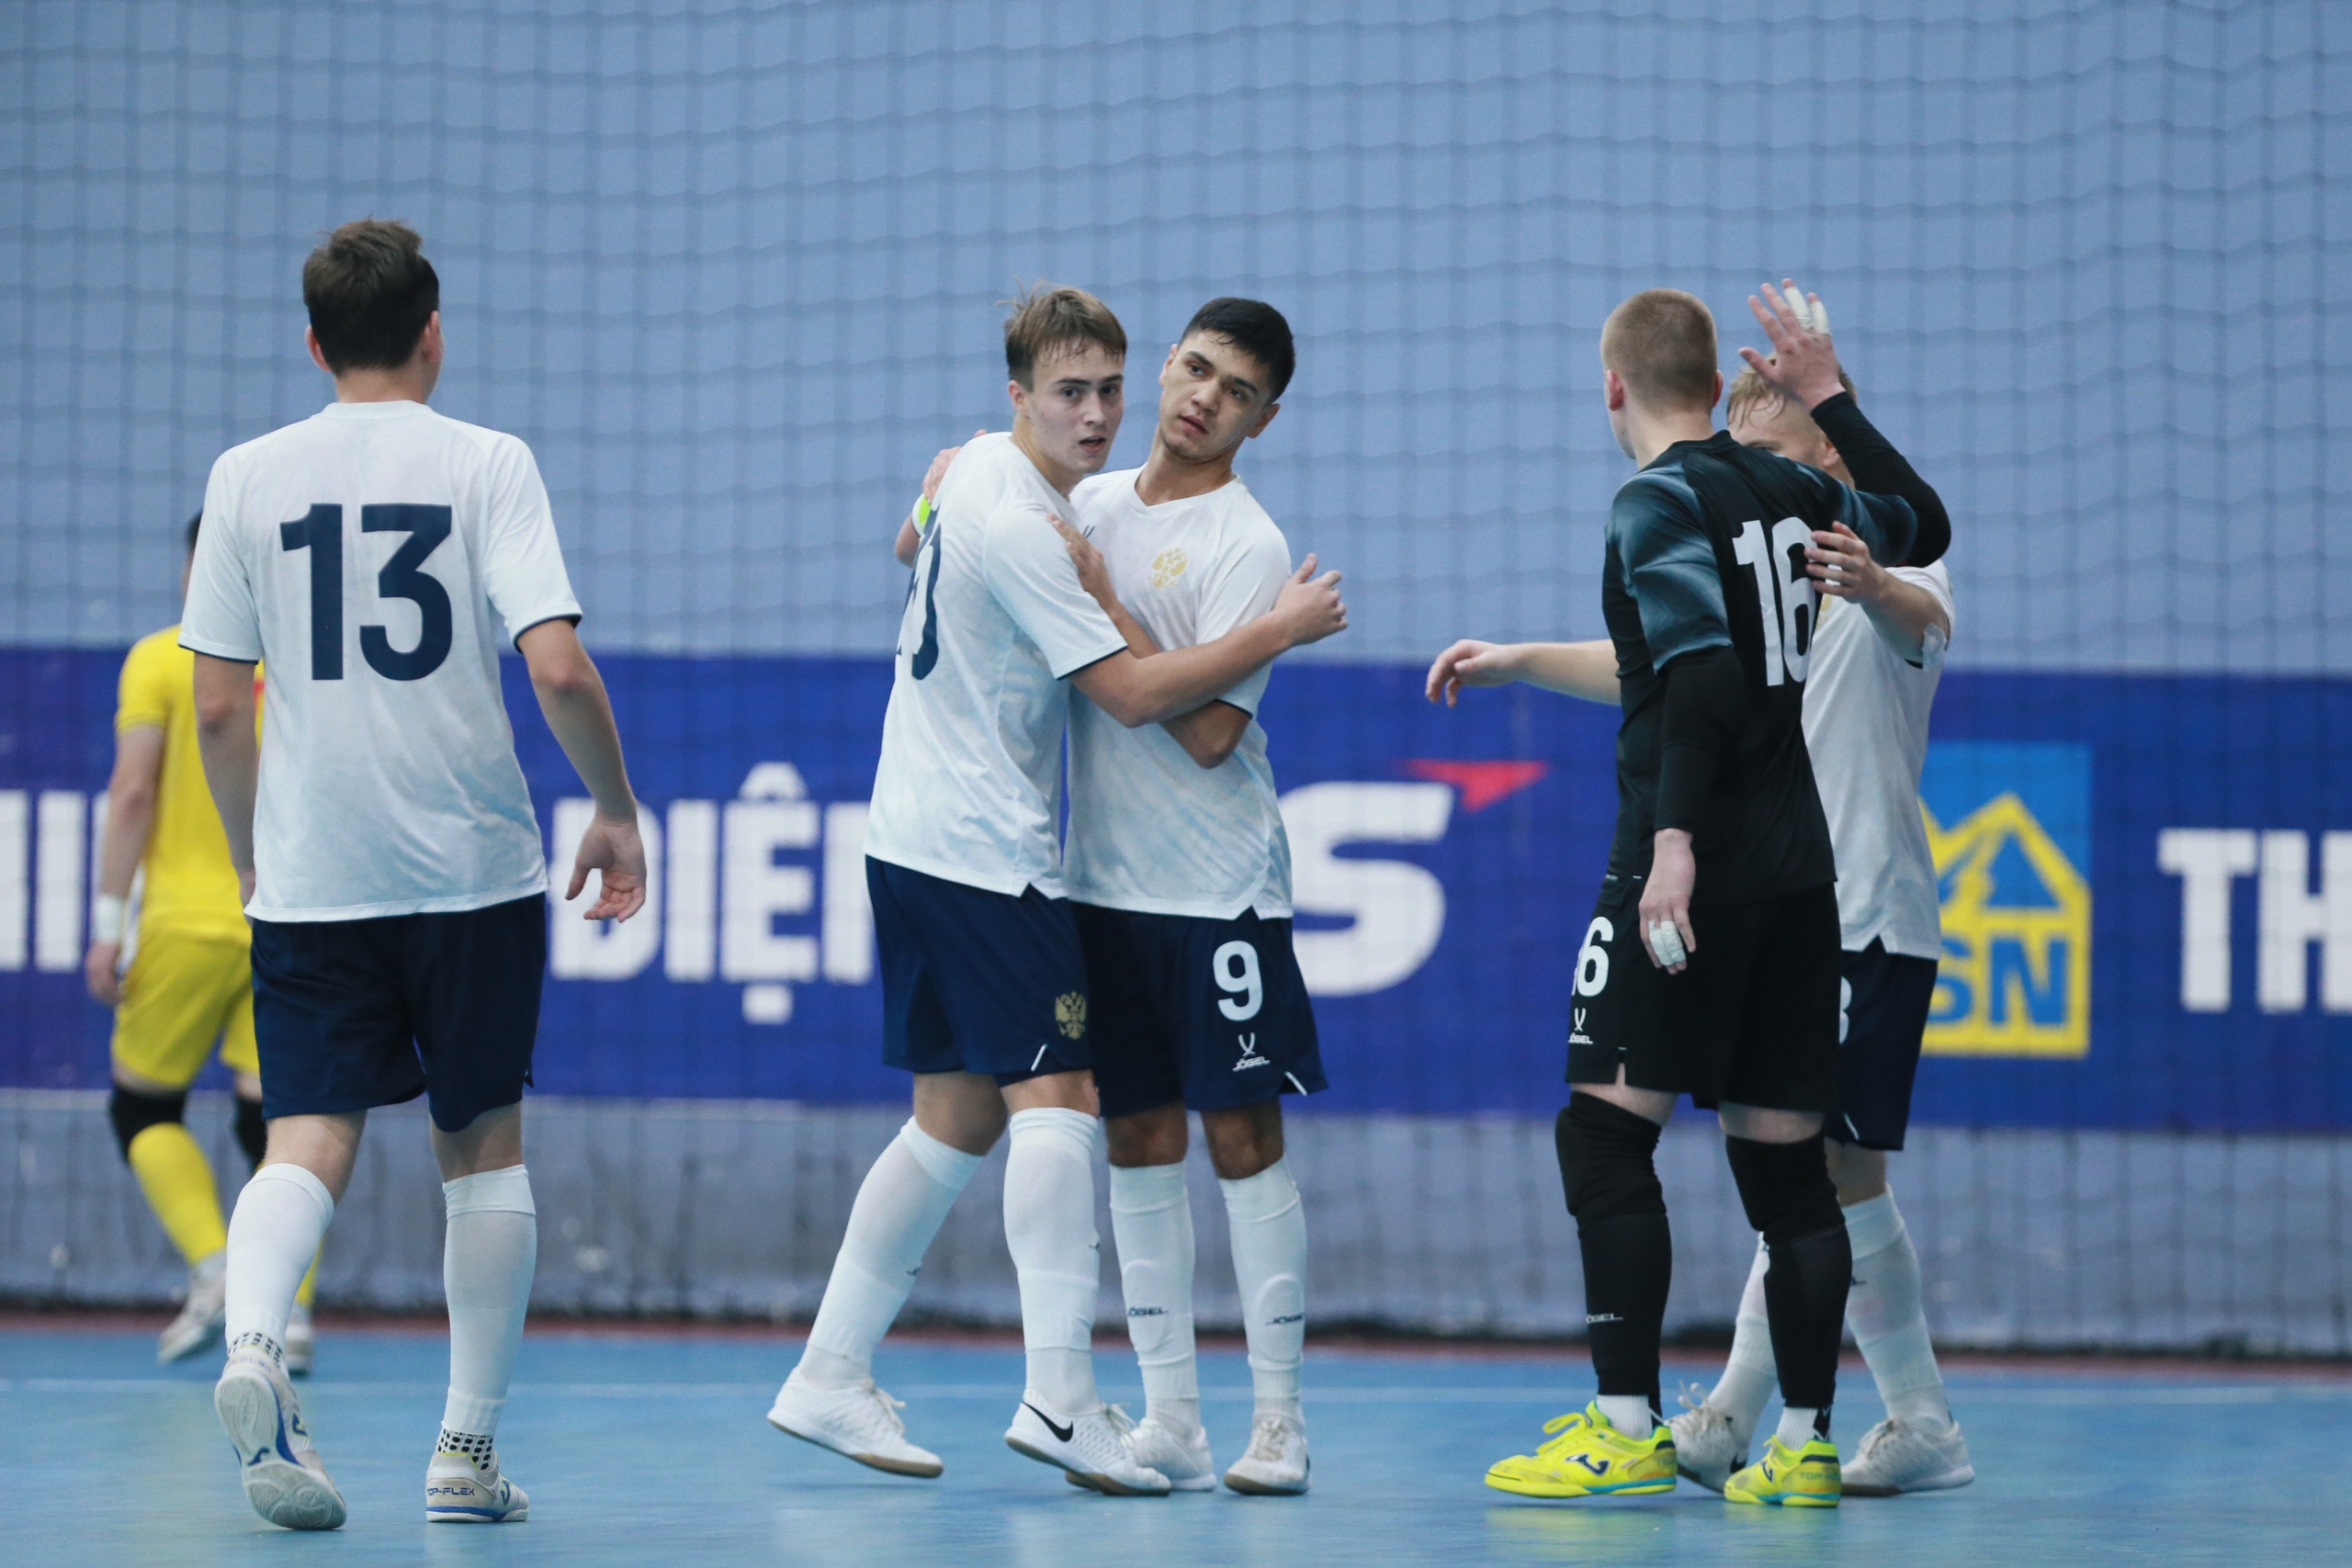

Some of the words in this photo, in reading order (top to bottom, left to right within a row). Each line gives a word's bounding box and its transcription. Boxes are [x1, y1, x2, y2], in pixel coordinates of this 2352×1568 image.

[279, 502, 453, 682] 13
[1732, 516, 1817, 686] 16
[1213, 940, 1263, 1021] 9
[2157, 829, 2352, 1013] TH
[1126, 1305, 1169, 1318] ÖGEL
[1586, 1313, 1624, 1325] ÖGEL
